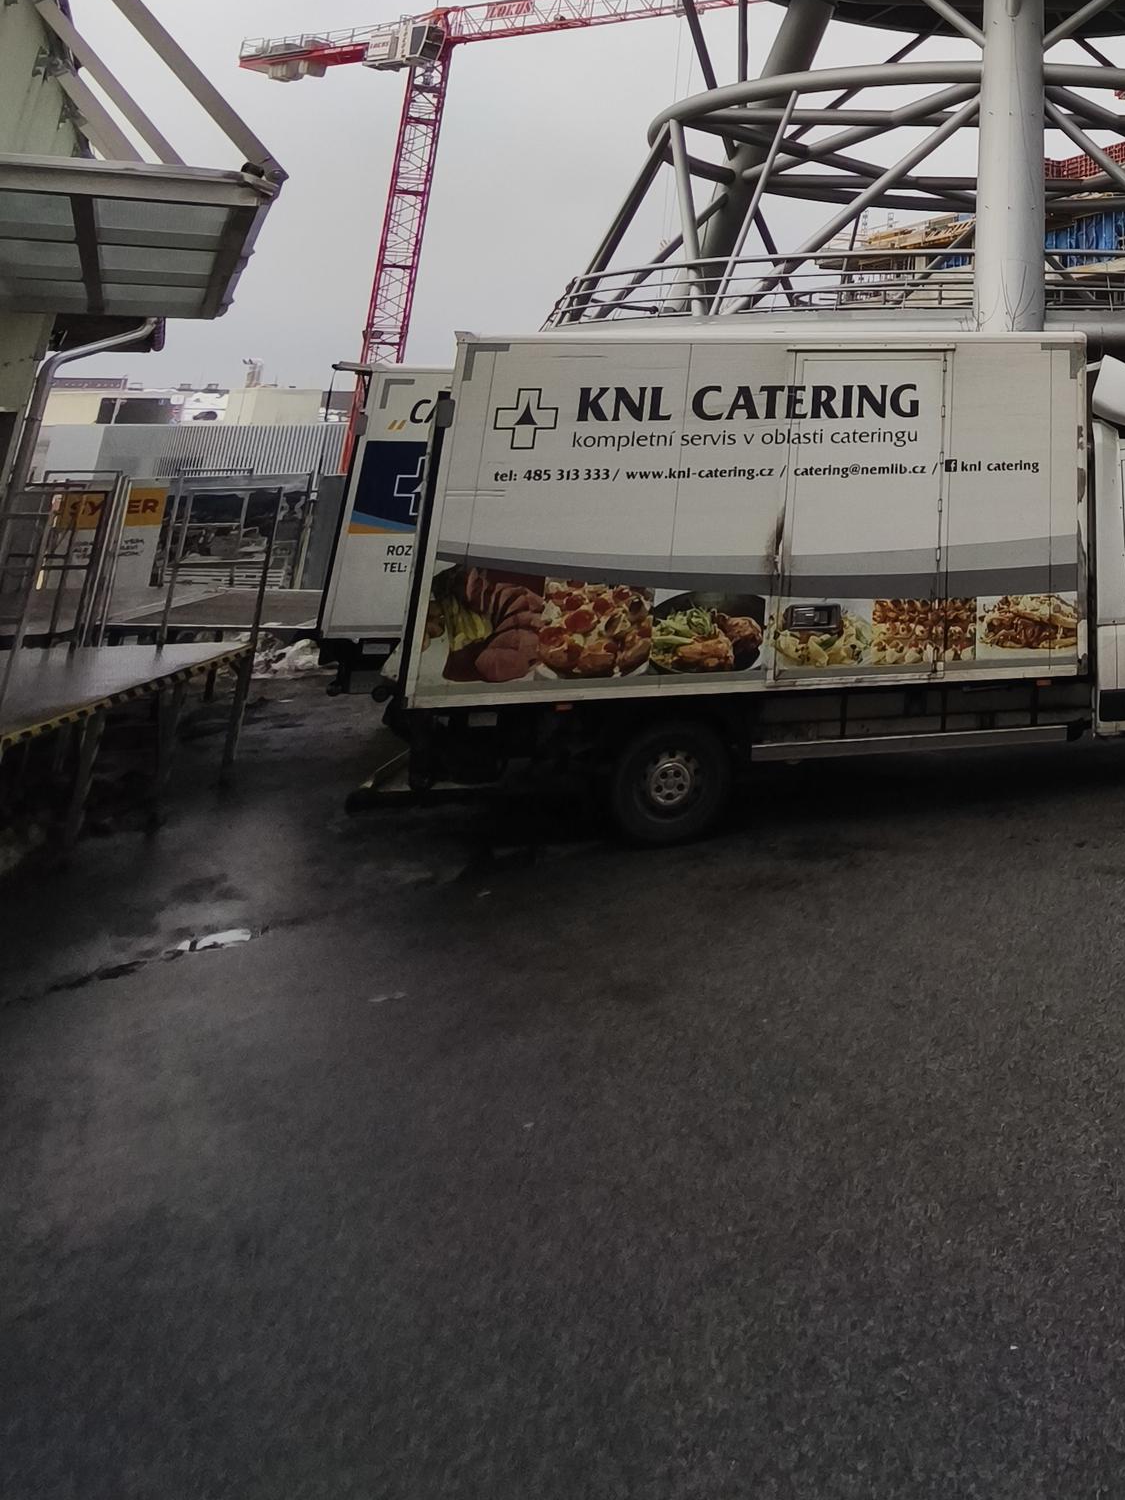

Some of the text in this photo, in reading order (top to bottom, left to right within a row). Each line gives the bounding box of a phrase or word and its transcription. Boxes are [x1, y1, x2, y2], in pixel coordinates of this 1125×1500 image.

[576, 383, 920, 422] KNL CATERING
[572, 428, 918, 451] kompletní servis v oblasti cateringu
[494, 470, 517, 482] tel:
[523, 470, 552, 482] 485
[556, 469, 580, 481] 313
[626, 466, 774, 481] www.knl-catering.cz
[794, 463, 927, 479] catering@nemlib.cz
[961, 460, 982, 473] knl
[987, 460, 1040, 474] catering
[386, 545, 413, 556] ROZ
[383, 562, 408, 573] TEL:
